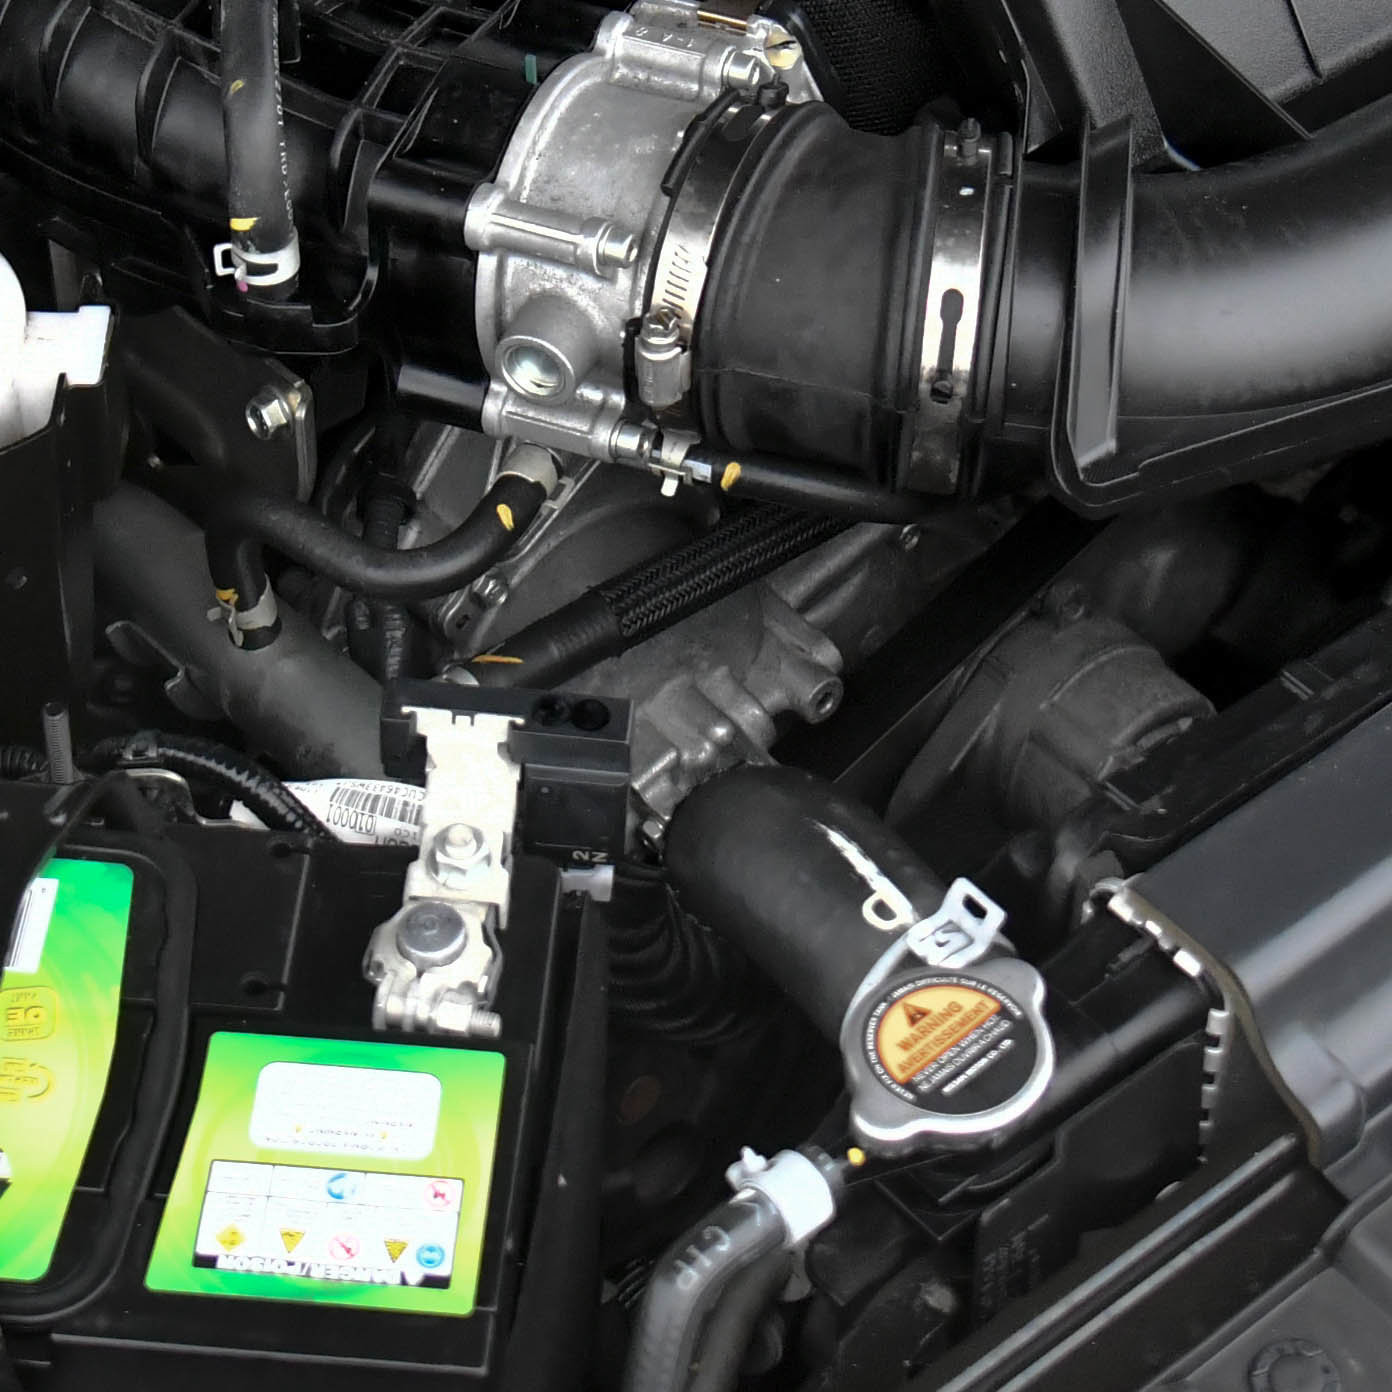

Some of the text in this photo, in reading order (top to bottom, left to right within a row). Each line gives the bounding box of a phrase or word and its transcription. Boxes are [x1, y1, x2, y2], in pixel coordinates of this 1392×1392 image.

[325, 802, 374, 833] 010001
[897, 1000, 964, 1051] WARNING
[897, 1000, 986, 1074] AVERTISSEMENT
[912, 1062, 938, 1081] NEVER
[937, 1046, 960, 1063] OPEN
[958, 1028, 984, 1047] WHEN
